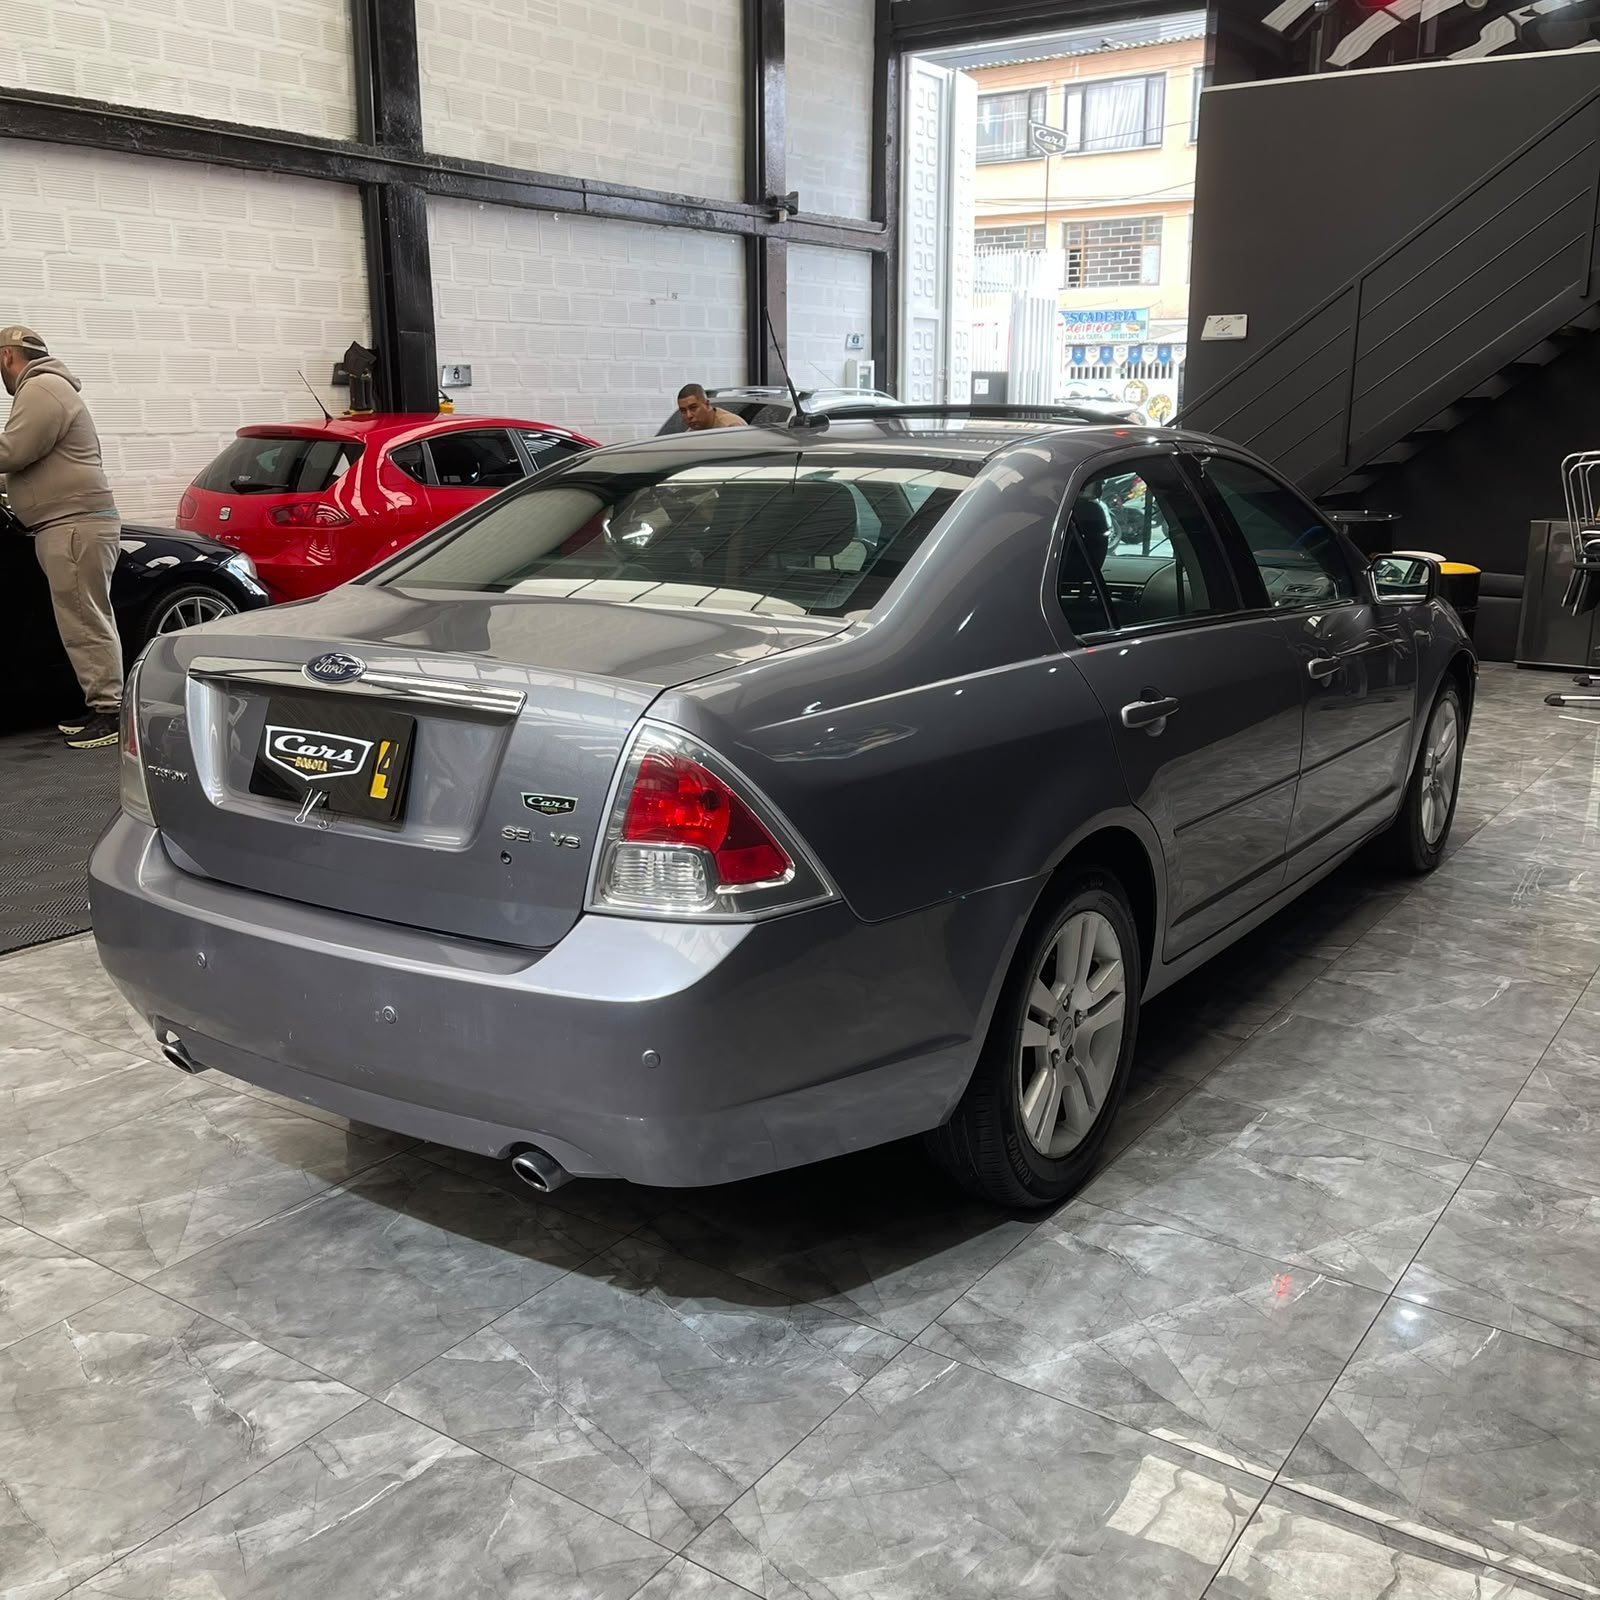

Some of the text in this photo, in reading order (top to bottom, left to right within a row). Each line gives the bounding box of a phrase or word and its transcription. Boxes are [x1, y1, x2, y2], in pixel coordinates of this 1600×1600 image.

[1035, 130, 1065, 146] Cars
[314, 655, 350, 675] Ford
[274, 735, 355, 763] Cars
[527, 796, 571, 809] Cars
